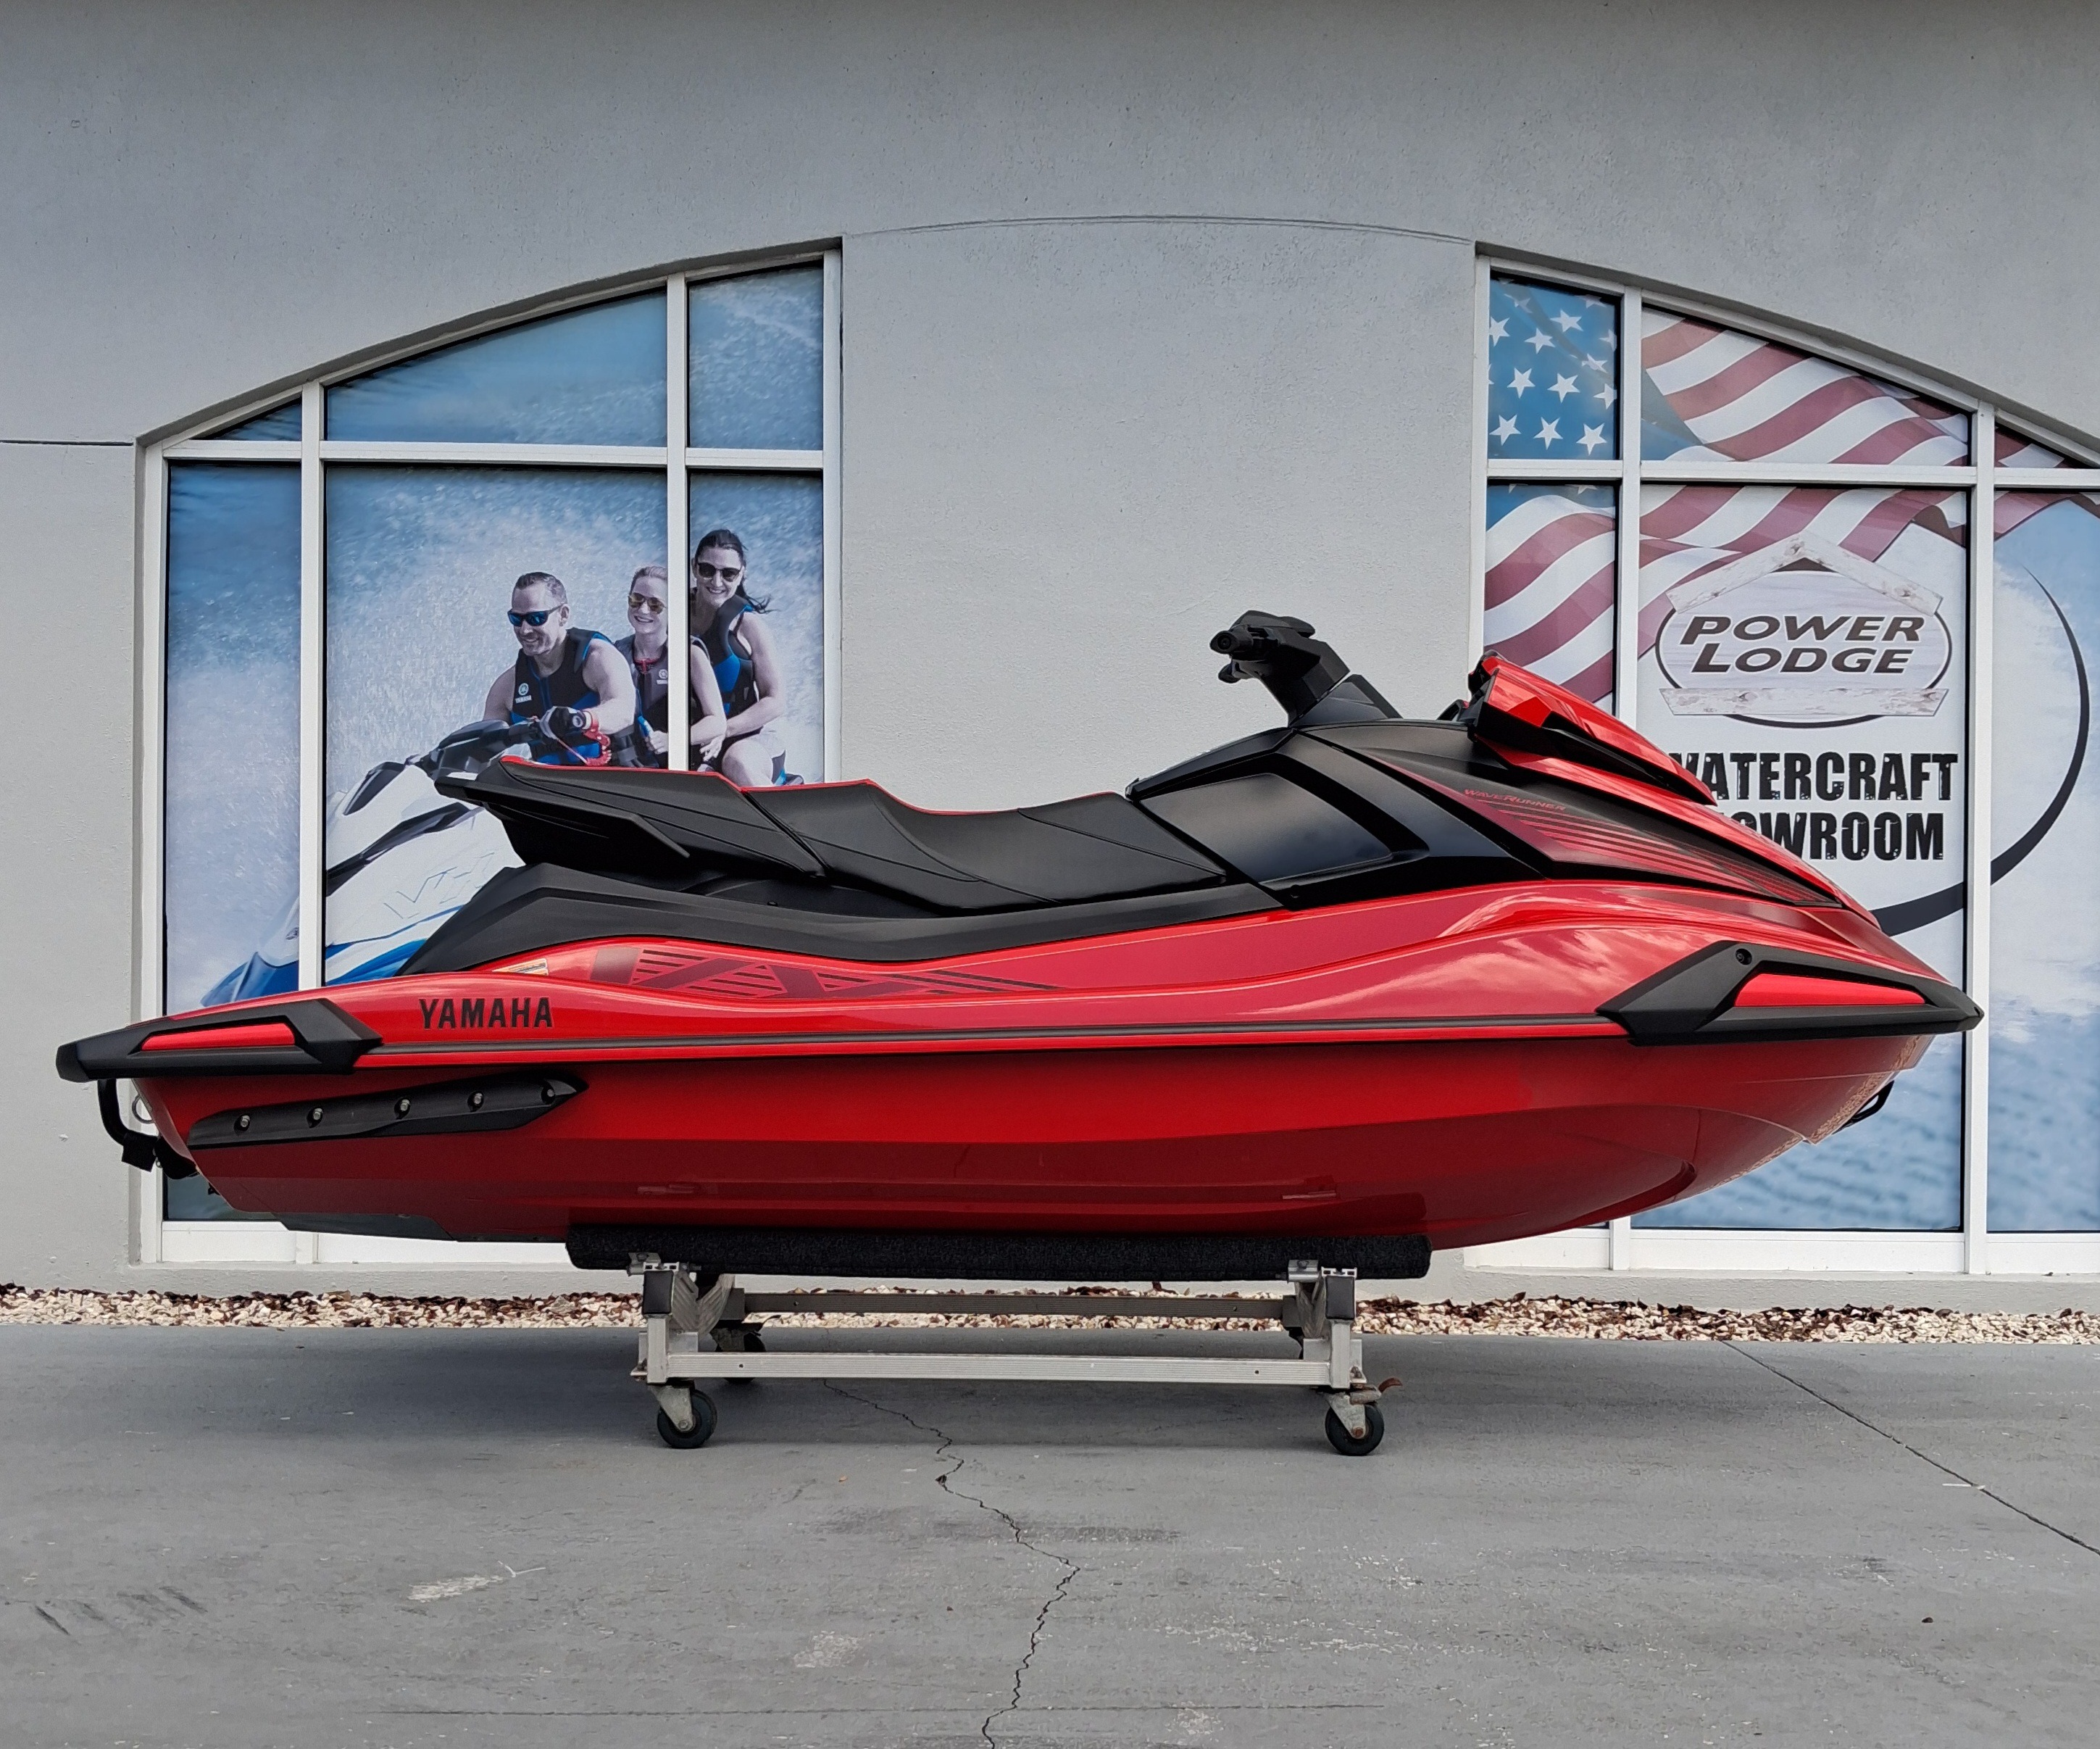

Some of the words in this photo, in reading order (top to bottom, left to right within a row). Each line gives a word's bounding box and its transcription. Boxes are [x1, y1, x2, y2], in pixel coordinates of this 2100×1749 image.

[1680, 616, 1924, 644] POWER
[1691, 643, 1913, 673] LODGE
[1719, 811, 1943, 860] WROOM
[419, 997, 553, 1029] YAMAHA
